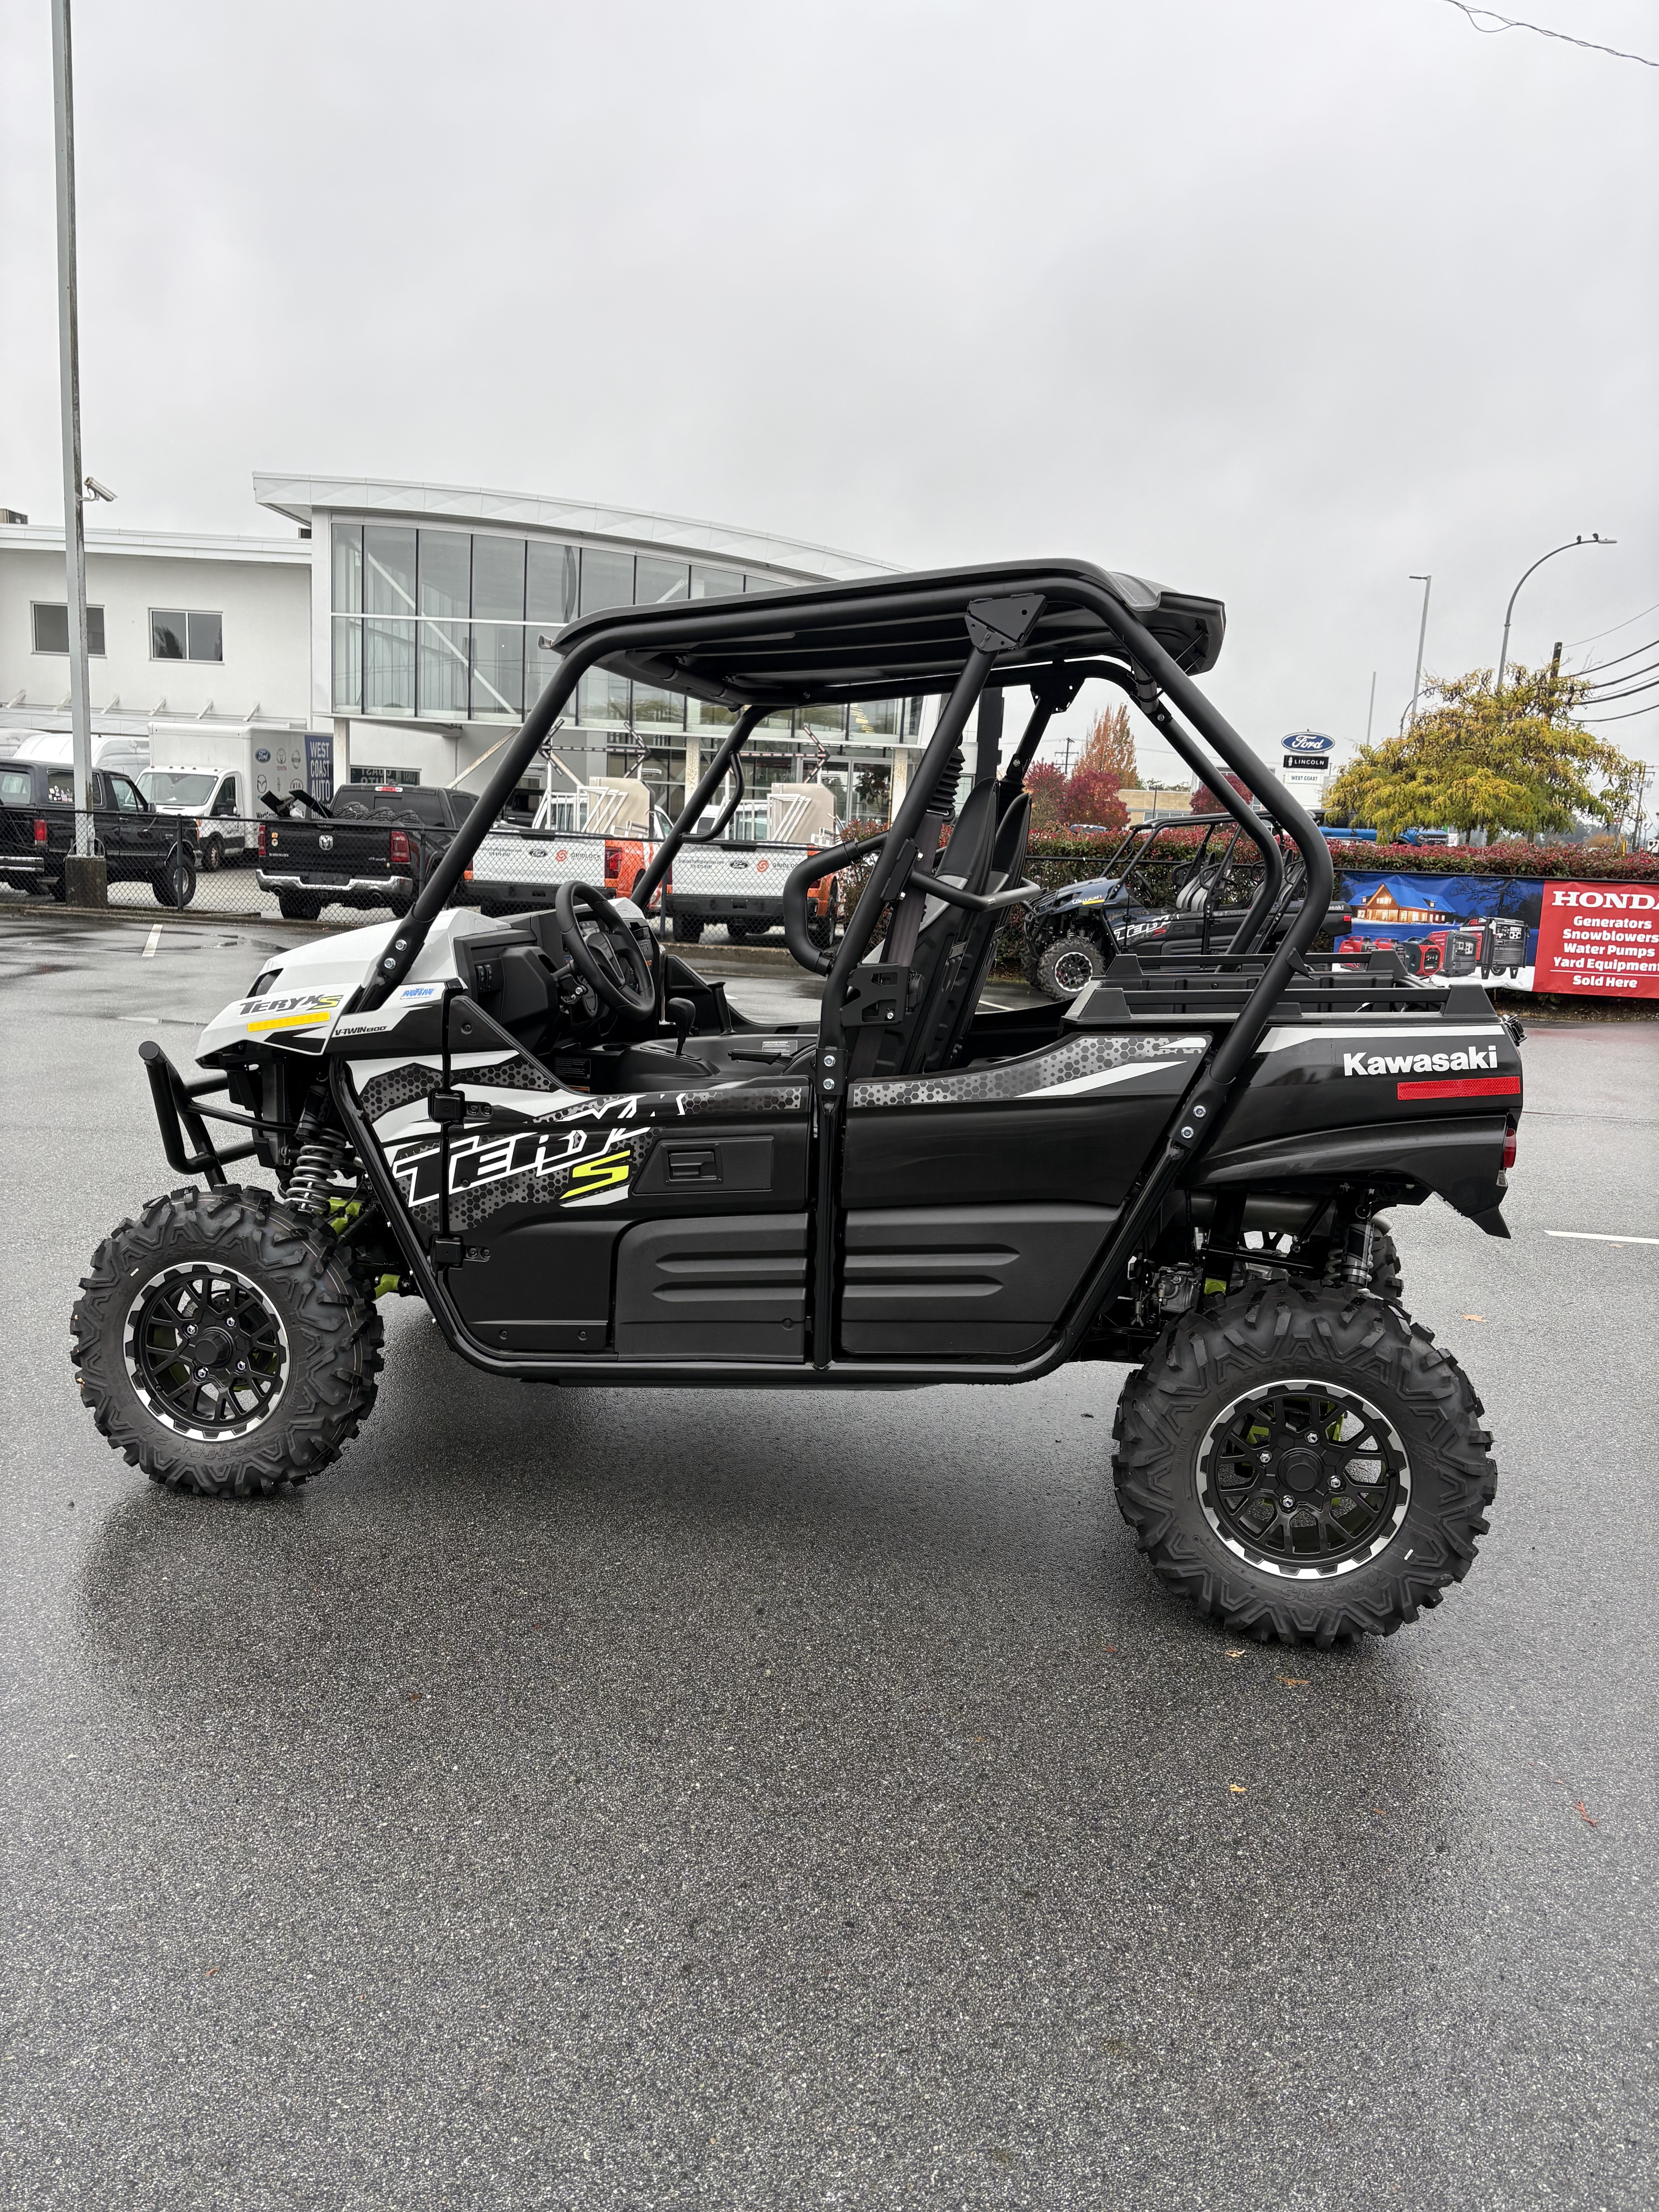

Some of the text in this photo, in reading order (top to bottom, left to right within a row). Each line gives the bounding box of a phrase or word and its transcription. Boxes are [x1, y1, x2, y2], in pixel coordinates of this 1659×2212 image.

[1292, 735, 1324, 749] Ford
[258, 750, 268, 760] Ford
[310, 742, 329, 758] WEST
[310, 760, 330, 778] COAST
[311, 780, 330, 801] AUTO
[1552, 891, 1659, 910] HOND
[1573, 915, 1652, 929] Generators
[1562, 928, 1659, 943] Snowblowers
[1564, 943, 1656, 958] Water Pumps
[1553, 957, 1585, 968] Yard
[1573, 975, 1638, 988] Sold Here
[335, 1026, 367, 1036] V-TWIN
[1343, 1045, 1498, 1076] Kawasaki
[1280, 1568, 1387, 1601] MAXXIS
